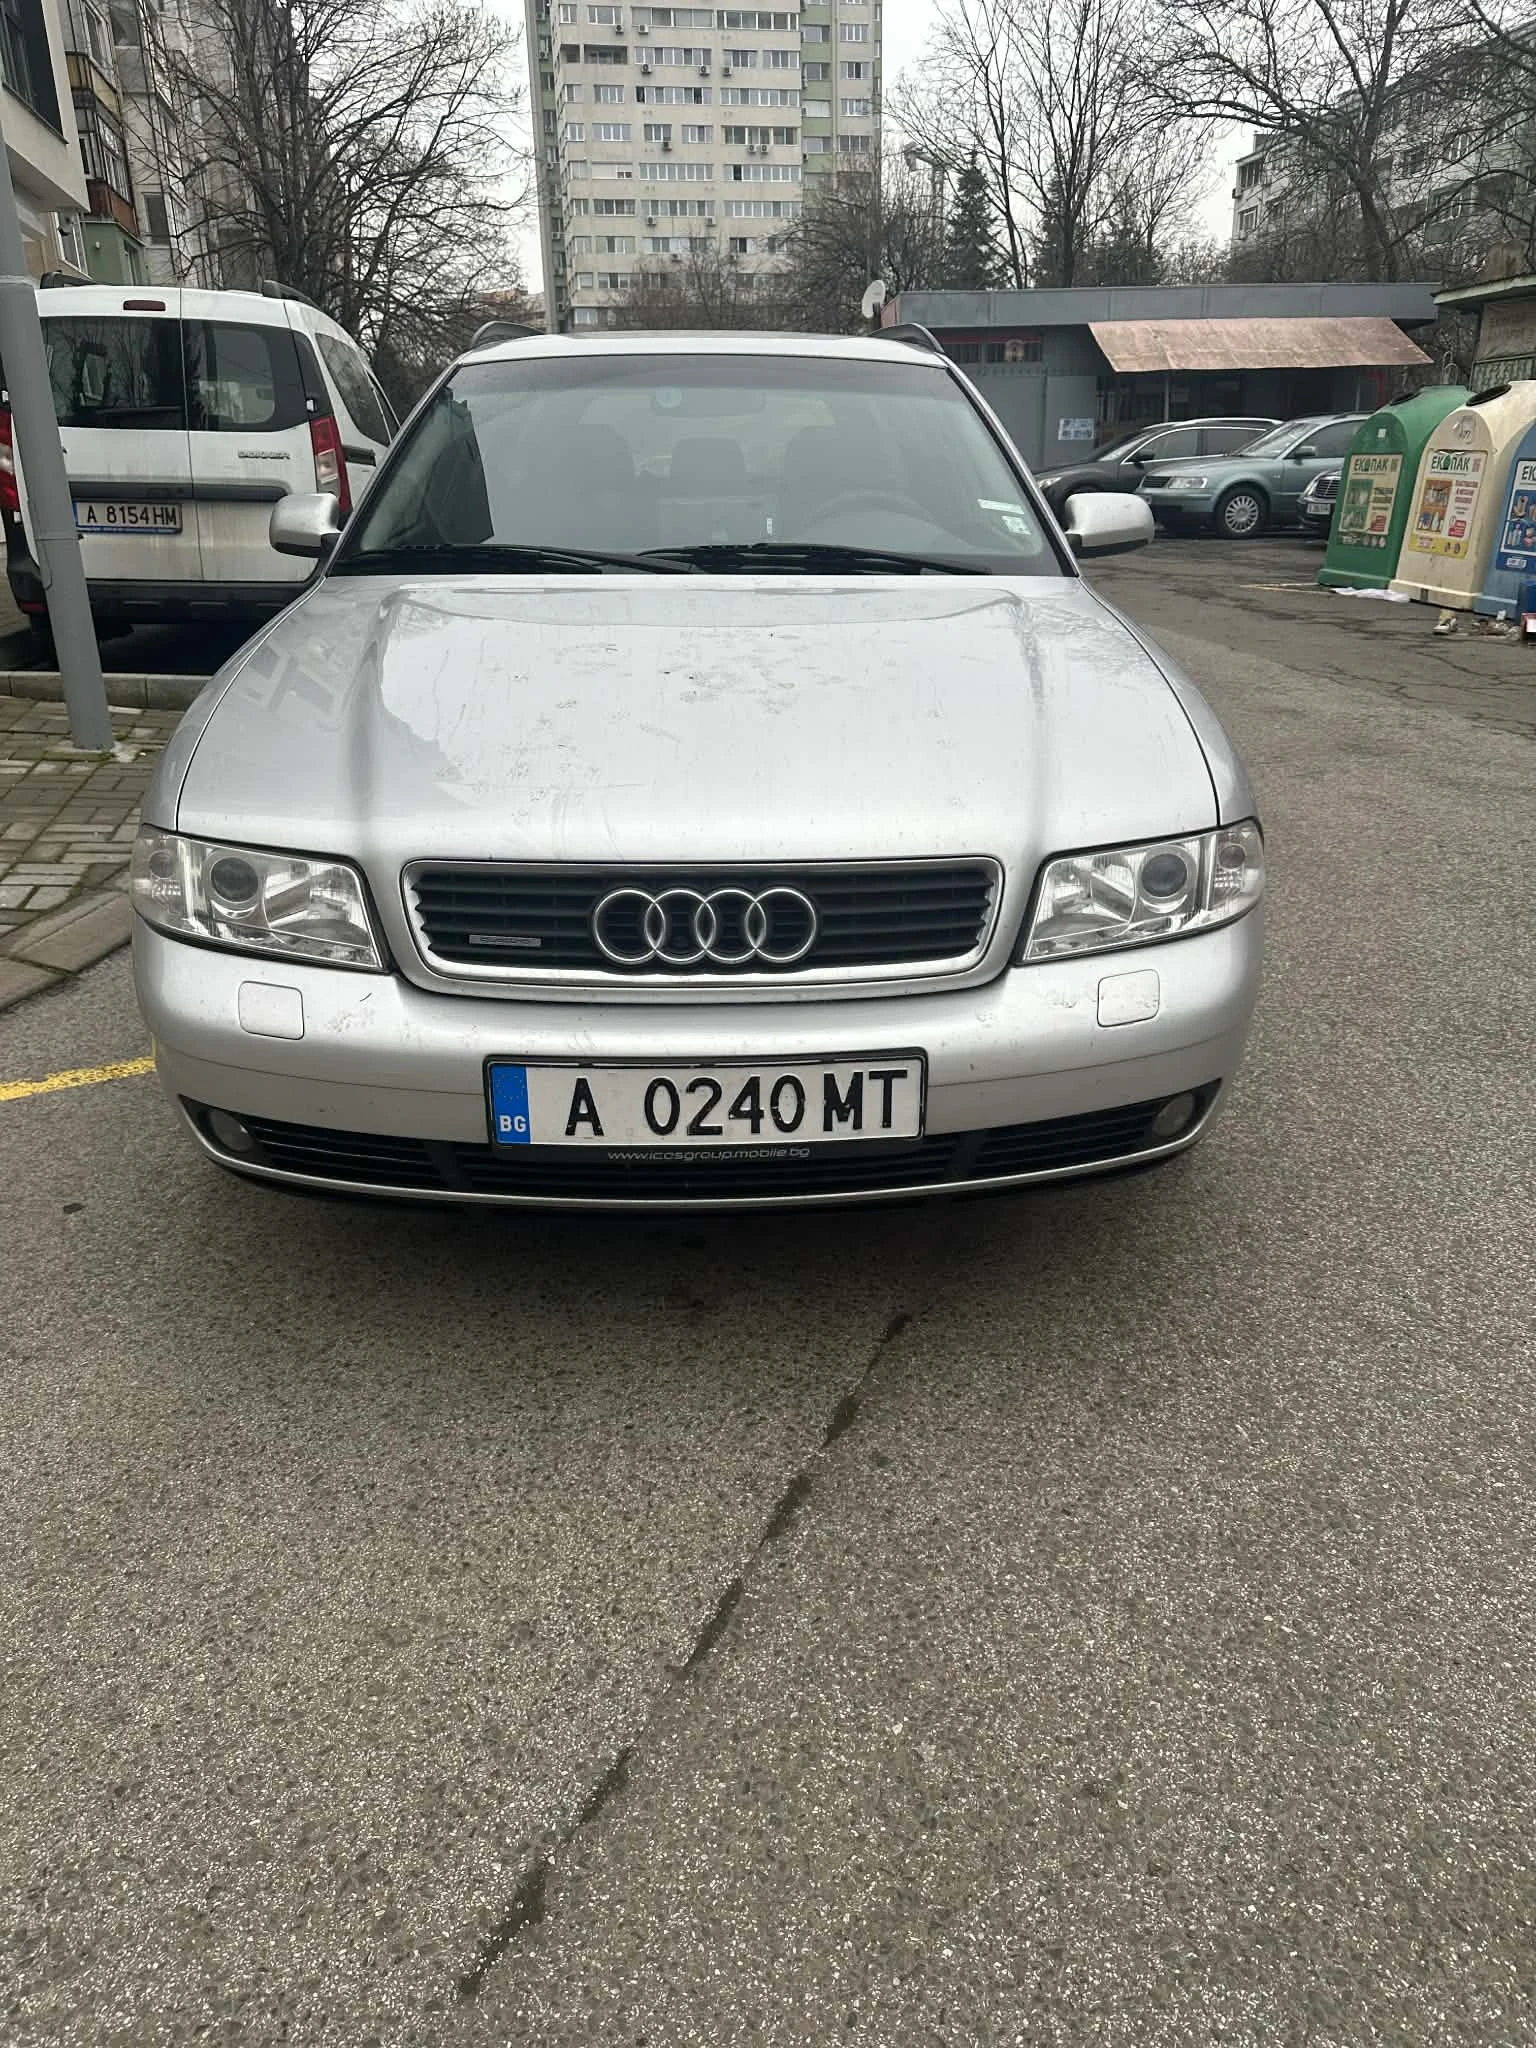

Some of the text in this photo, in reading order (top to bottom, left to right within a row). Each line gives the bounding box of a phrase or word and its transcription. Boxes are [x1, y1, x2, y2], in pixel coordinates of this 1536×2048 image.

[87, 505, 177, 525] A 8154 HM
[564, 1069, 908, 1137] A 0240 MT
[499, 1115, 527, 1133] BG
